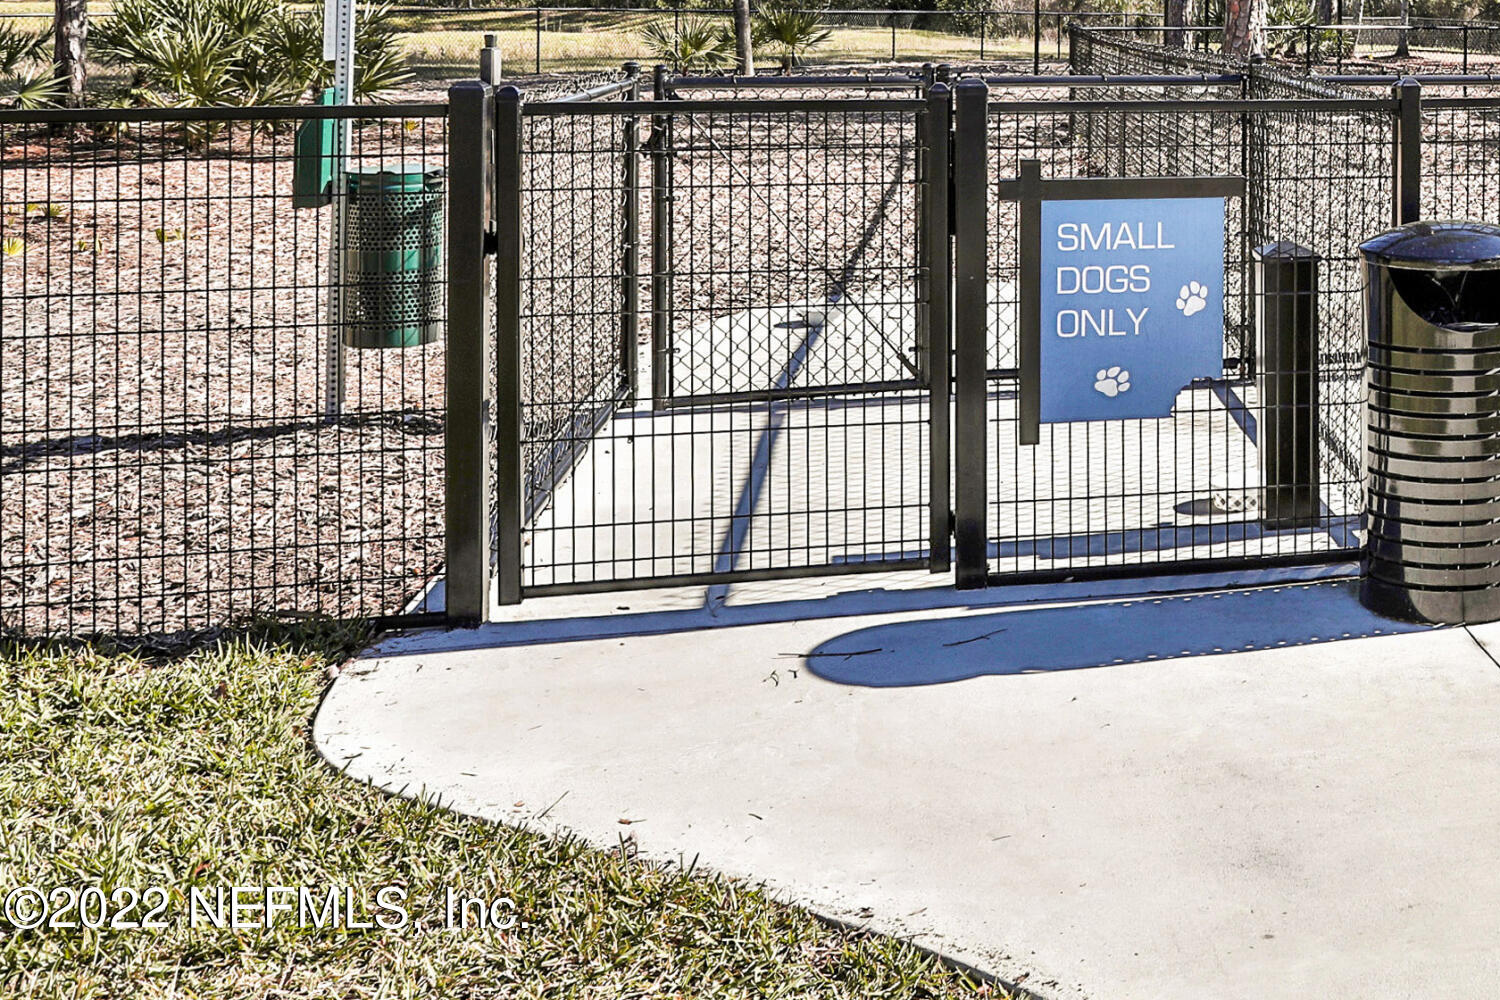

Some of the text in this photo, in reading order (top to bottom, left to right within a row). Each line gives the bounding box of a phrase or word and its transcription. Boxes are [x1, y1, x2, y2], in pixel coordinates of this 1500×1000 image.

[1057, 221, 1175, 251] SMALL
[1057, 265, 1151, 295] DOGS
[1057, 307, 1149, 338] ONLY
